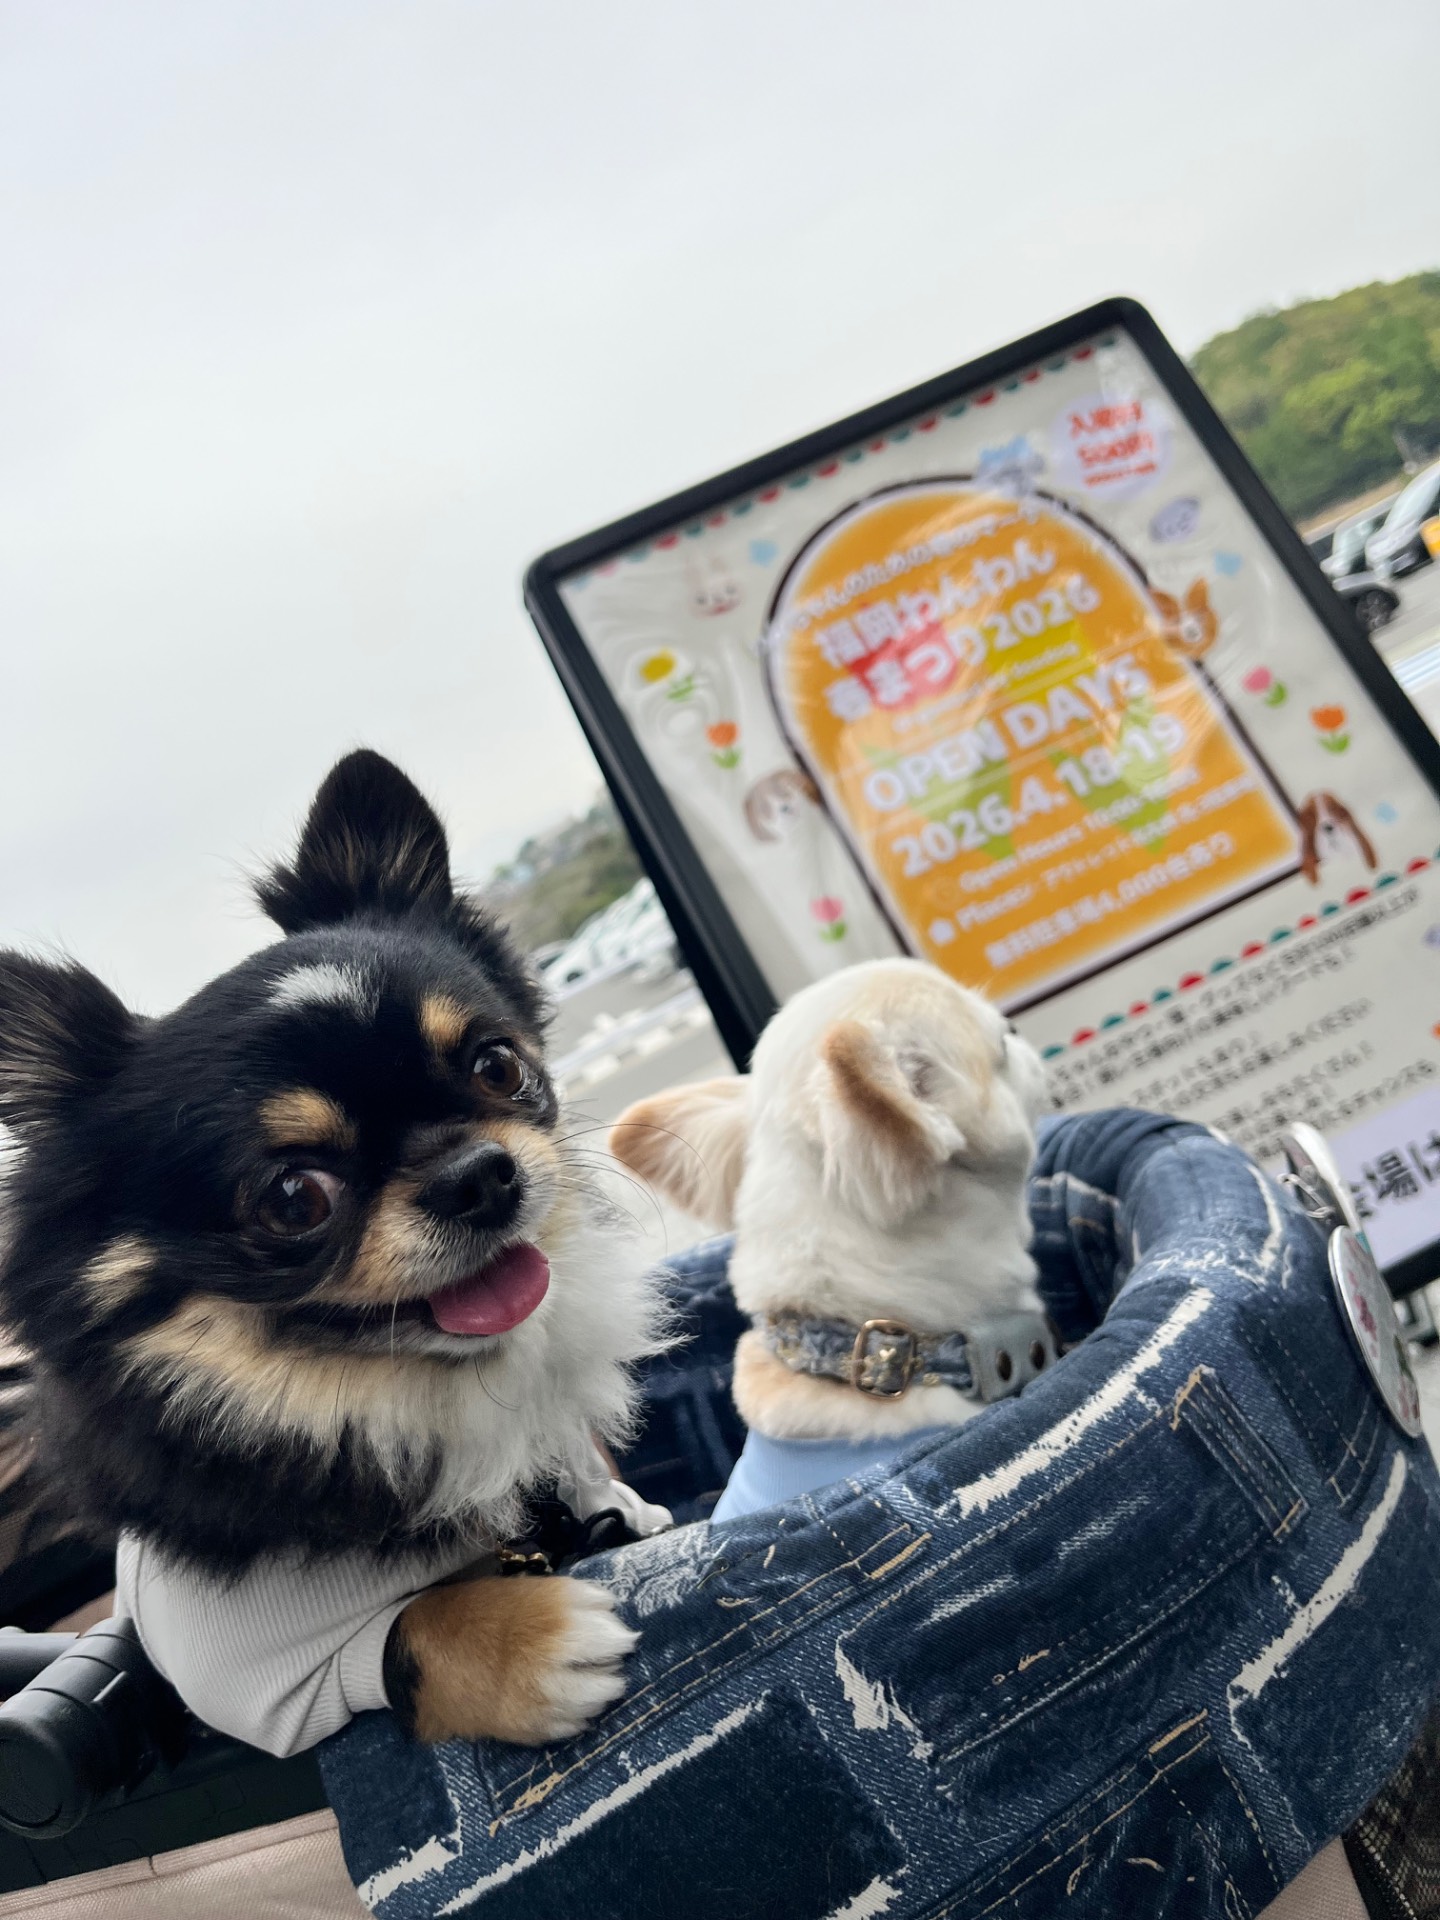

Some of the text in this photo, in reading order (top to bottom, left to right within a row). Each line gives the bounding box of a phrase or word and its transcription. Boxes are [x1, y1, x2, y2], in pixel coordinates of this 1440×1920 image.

[816, 538, 1056, 663] 福岡わんわん
[862, 654, 1150, 813] OPEN DAYS
[956, 850, 1018, 895] Open
[1015, 819, 1085, 864] Hours
